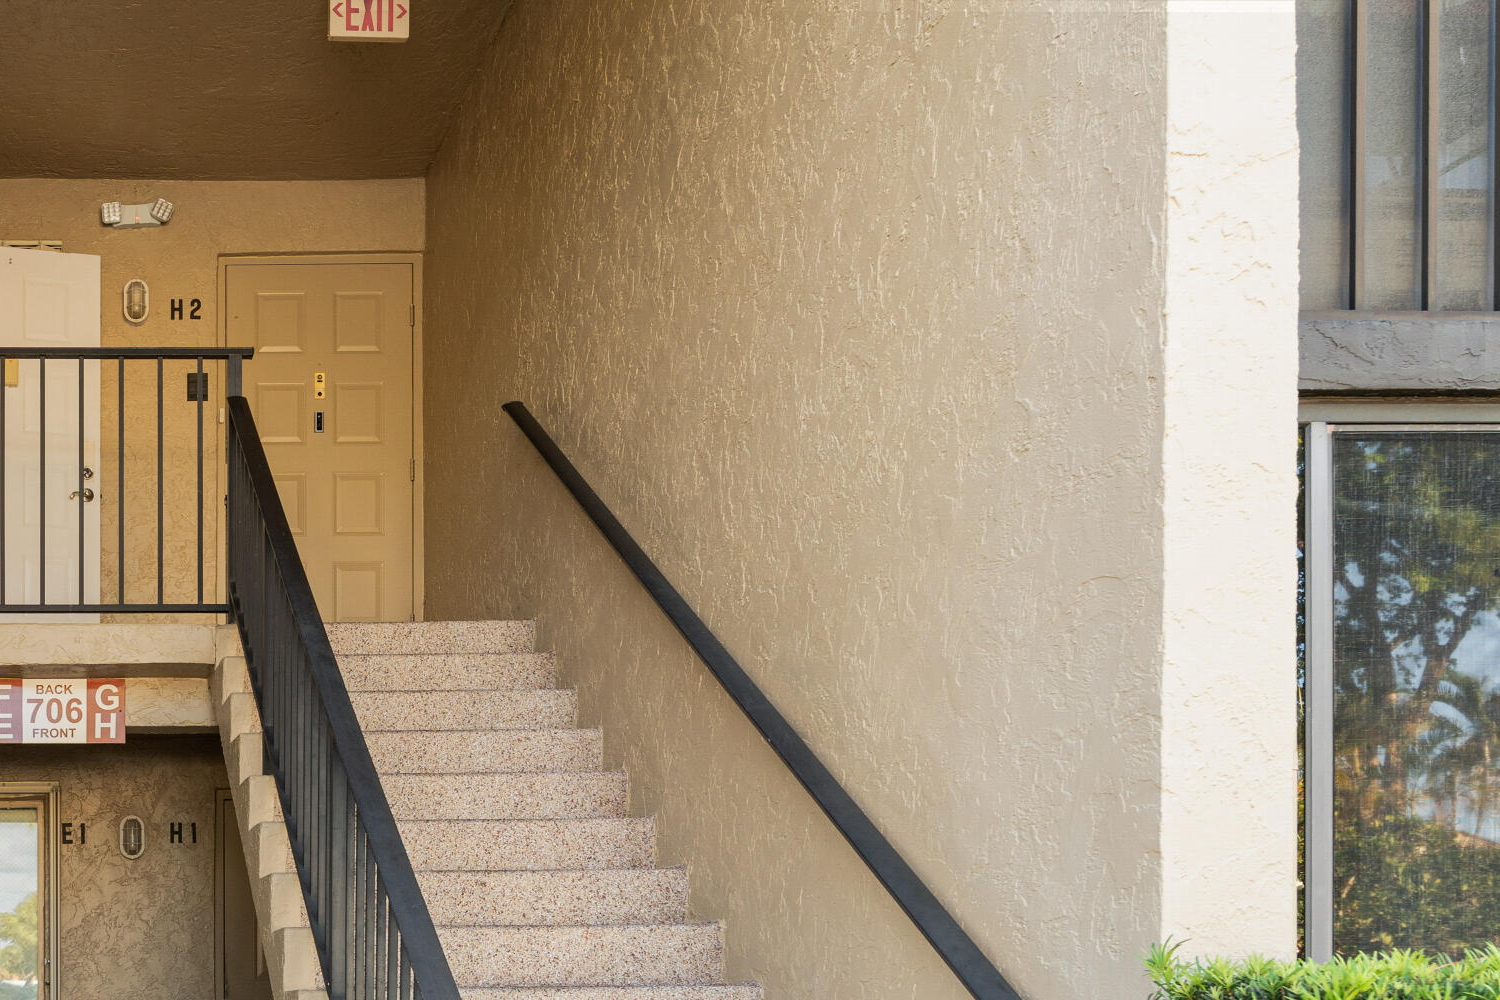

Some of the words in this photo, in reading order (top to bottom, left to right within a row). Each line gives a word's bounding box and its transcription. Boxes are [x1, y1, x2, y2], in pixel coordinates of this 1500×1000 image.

[170, 298, 201, 320] H2
[35, 684, 73, 695] BACK
[94, 684, 120, 711] G
[26, 697, 83, 724] 706
[32, 728, 77, 738] FRONT
[94, 713, 117, 739] H
[169, 822, 197, 844] H1
